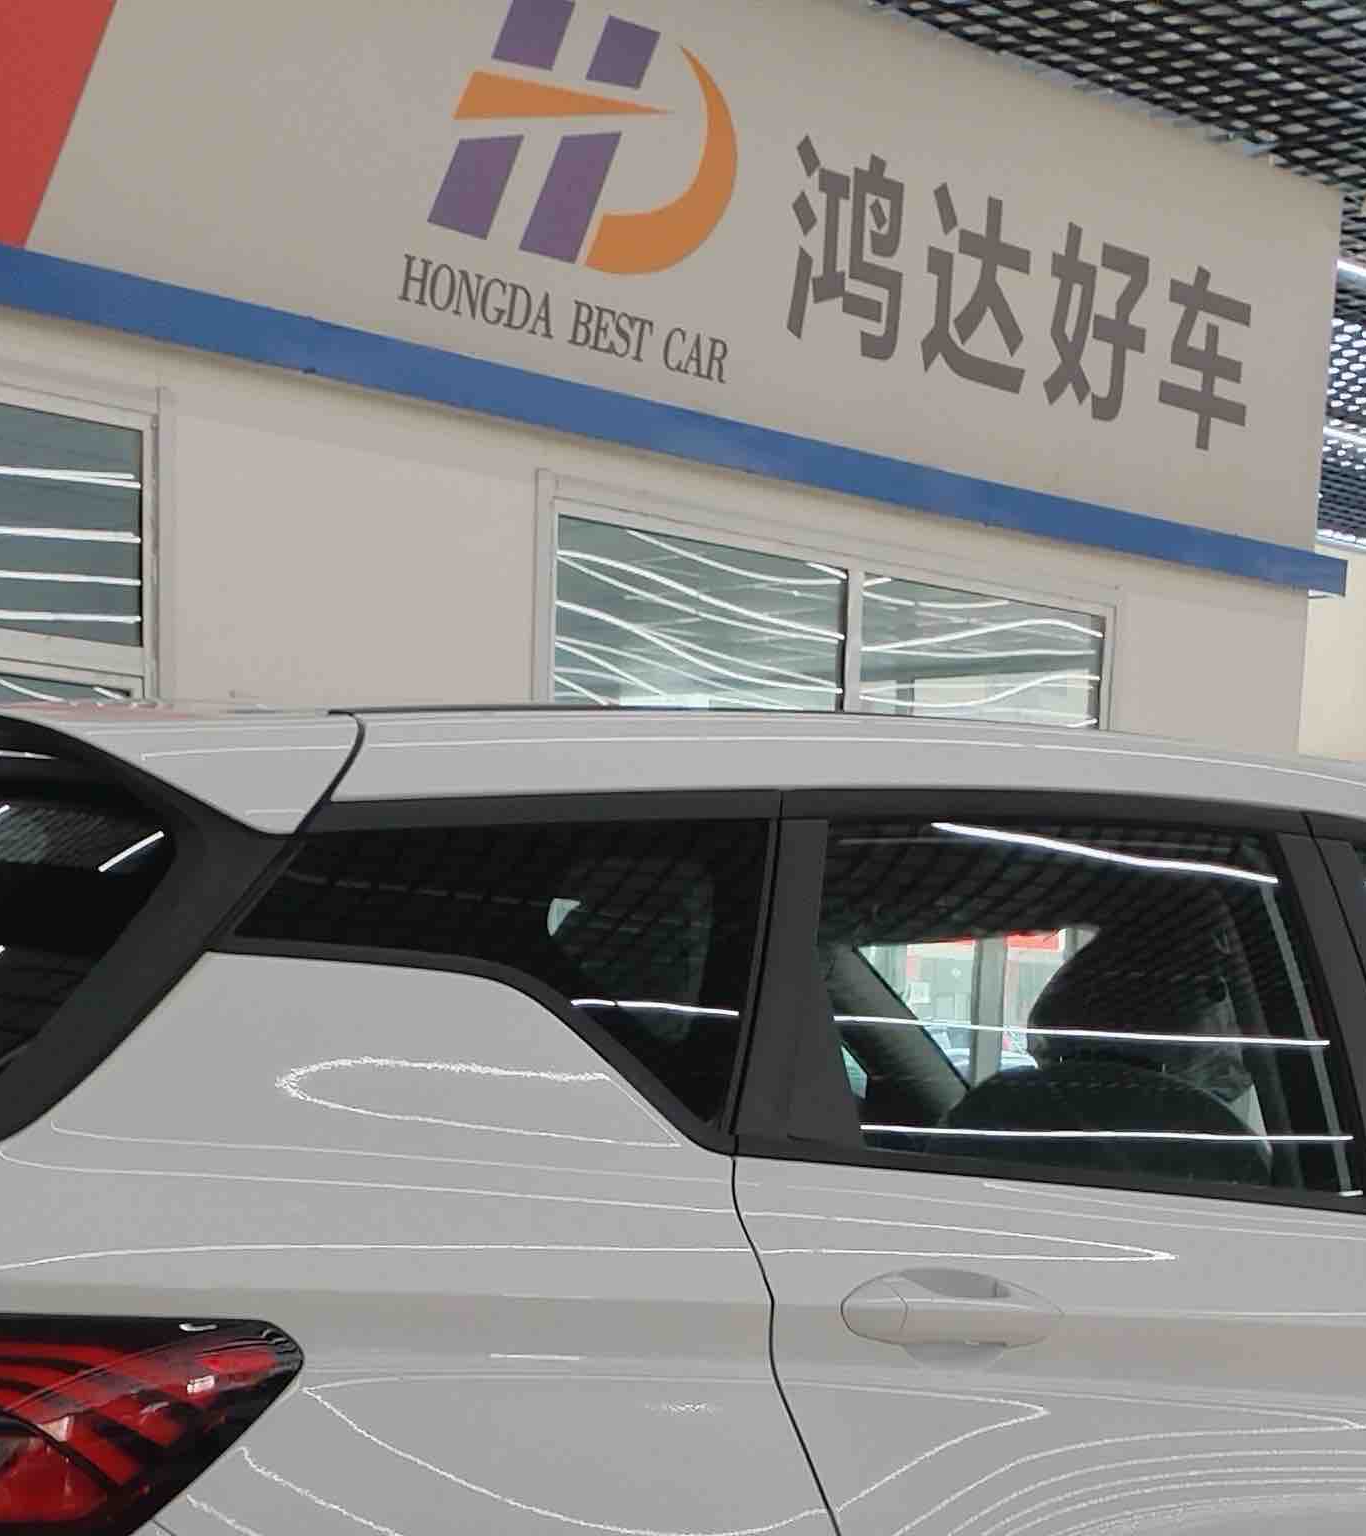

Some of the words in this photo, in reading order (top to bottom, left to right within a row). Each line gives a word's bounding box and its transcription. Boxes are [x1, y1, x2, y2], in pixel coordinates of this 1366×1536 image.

[398, 254, 554, 339] HONGDA
[568, 299, 653, 363] BEST
[662, 326, 729, 384] CAR
[787, 135, 1252, 451] 鸿达好车
